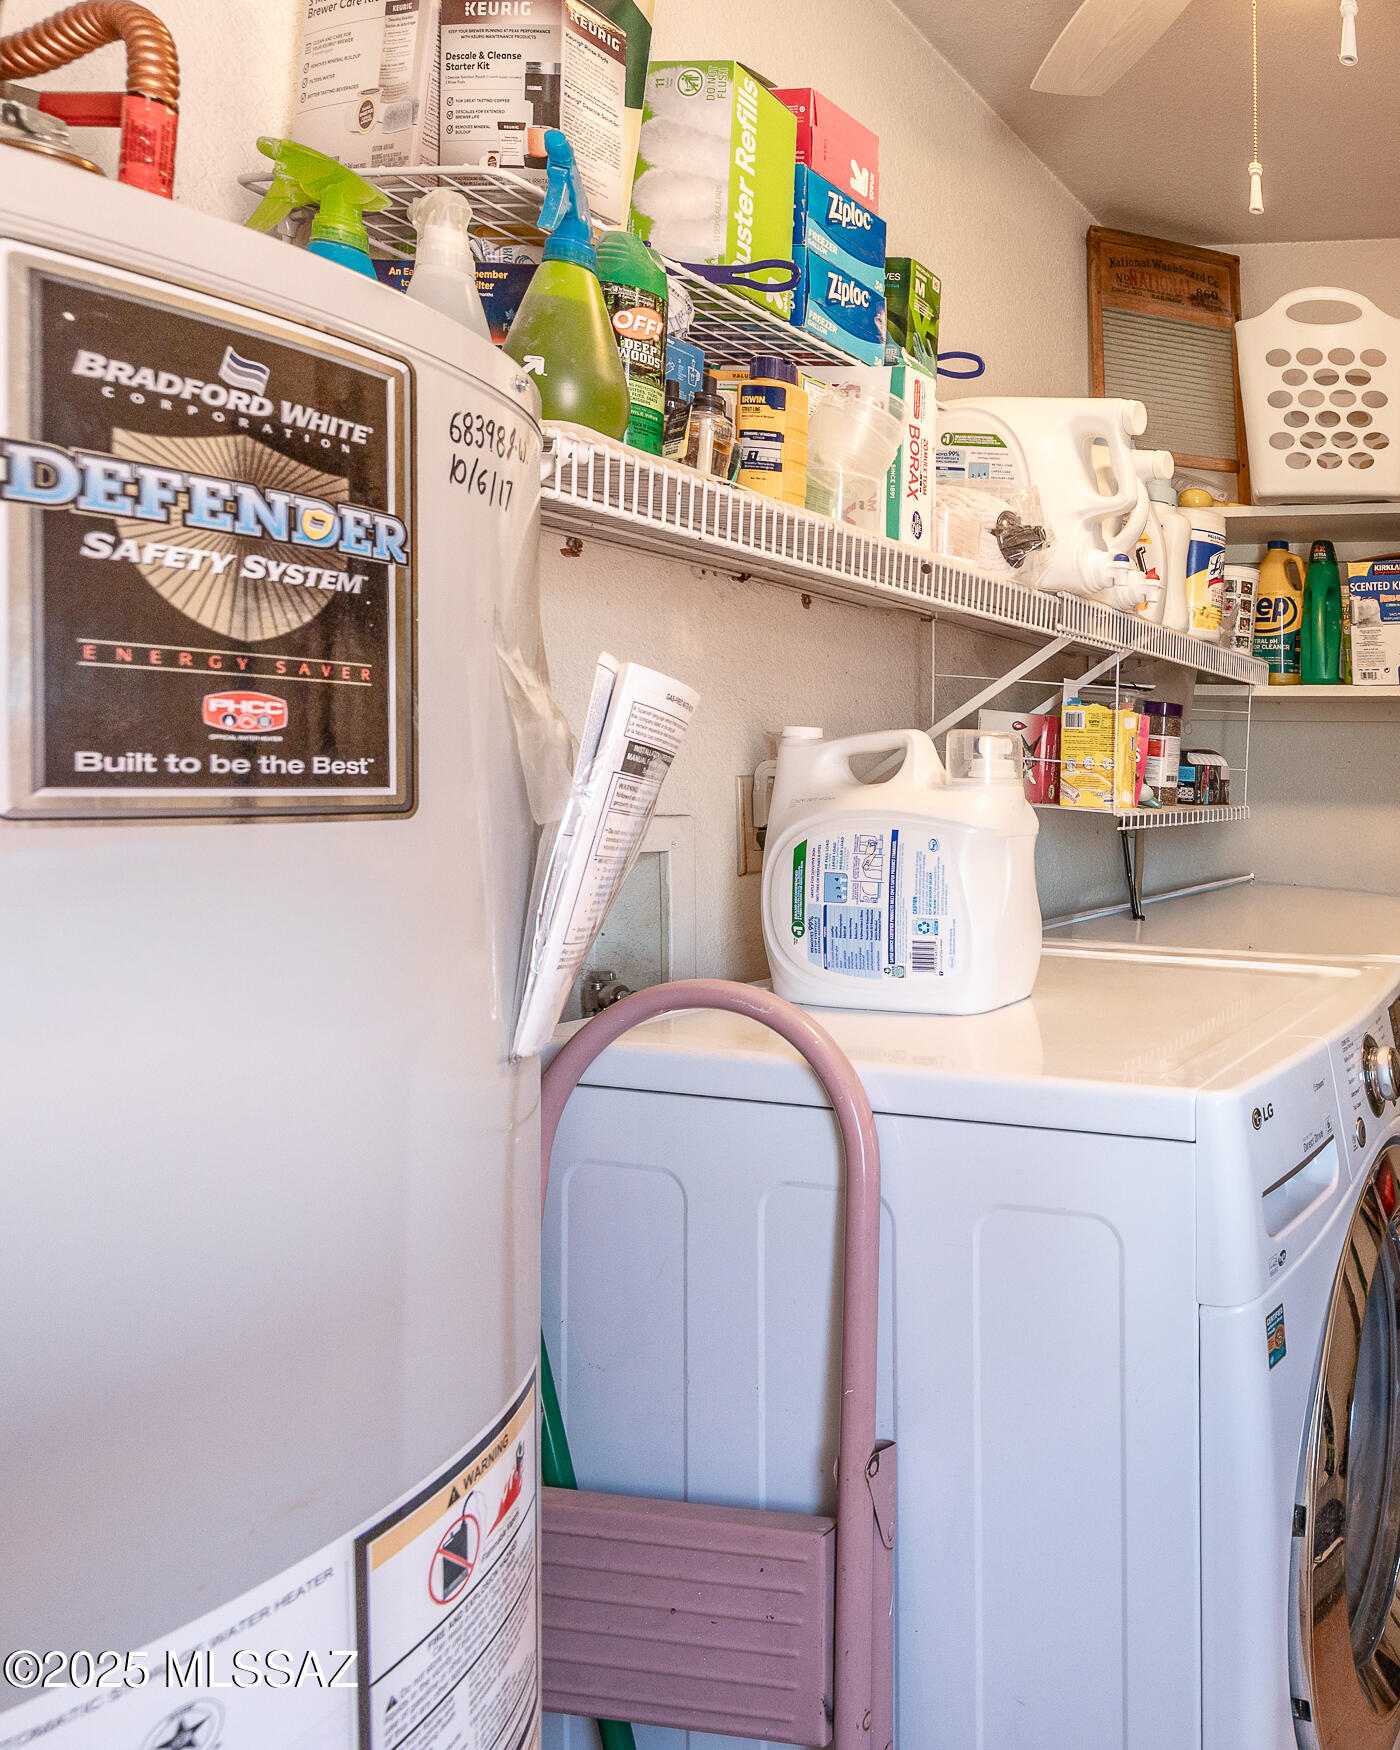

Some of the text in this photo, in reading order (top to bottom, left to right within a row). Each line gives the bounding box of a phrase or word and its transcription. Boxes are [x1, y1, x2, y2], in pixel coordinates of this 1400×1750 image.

[308, 2, 337, 19] Brewer
[392, 2, 413, 12] KEURIG
[464, 1, 532, 16] KEURIG
[570, 8, 621, 52] KEURIG
[445, 51, 522, 60] Descale & Cleanse
[445, 61, 490, 71] Starter Kit
[706, 65, 718, 101] DO NOT
[717, 67, 728, 99] FLUSH
[735, 76, 759, 177] Refills
[828, 190, 872, 230] Ziploc
[807, 237, 828, 256] GALLON
[808, 228, 838, 255] FREEZER
[388, 267, 401, 276] An
[475, 270, 508, 280] member
[475, 280, 495, 290] ilter
[1109, 257, 1221, 290] National Washboard Co.
[828, 271, 870, 308] Ziploc
[915, 277, 926, 299] M
[613, 309, 664, 341] OFF!
[807, 319, 828, 336] GALLON
[808, 310, 837, 334] FREEZER
[618, 347, 661, 369] WOODS
[624, 338, 657, 355] DEEP
[72, 349, 369, 445] BRADFORD WHITE
[741, 395, 766, 404] IRWIN
[101, 386, 350, 453] CORPORATION
[906, 423, 921, 501] BORAX
[449, 453, 514, 512] 10/6/17
[3, 442, 411, 565] DEFENDER
[79, 531, 366, 594] SAFETY SYSTEM
[1350, 581, 1390, 592] SCENTED
[1256, 597, 1289, 623] ep
[82, 644, 371, 681] ENERGY SAVER
[208, 698, 284, 715] PHCC
[73, 751, 157, 773] Built
[164, 753, 202, 773] to
[209, 754, 251, 774] be
[257, 755, 305, 775] the
[1262, 1102, 1274, 1122] LG
[462, 1432, 511, 1491] WARNING
[209, 1566, 335, 1649] WATER HEATER
